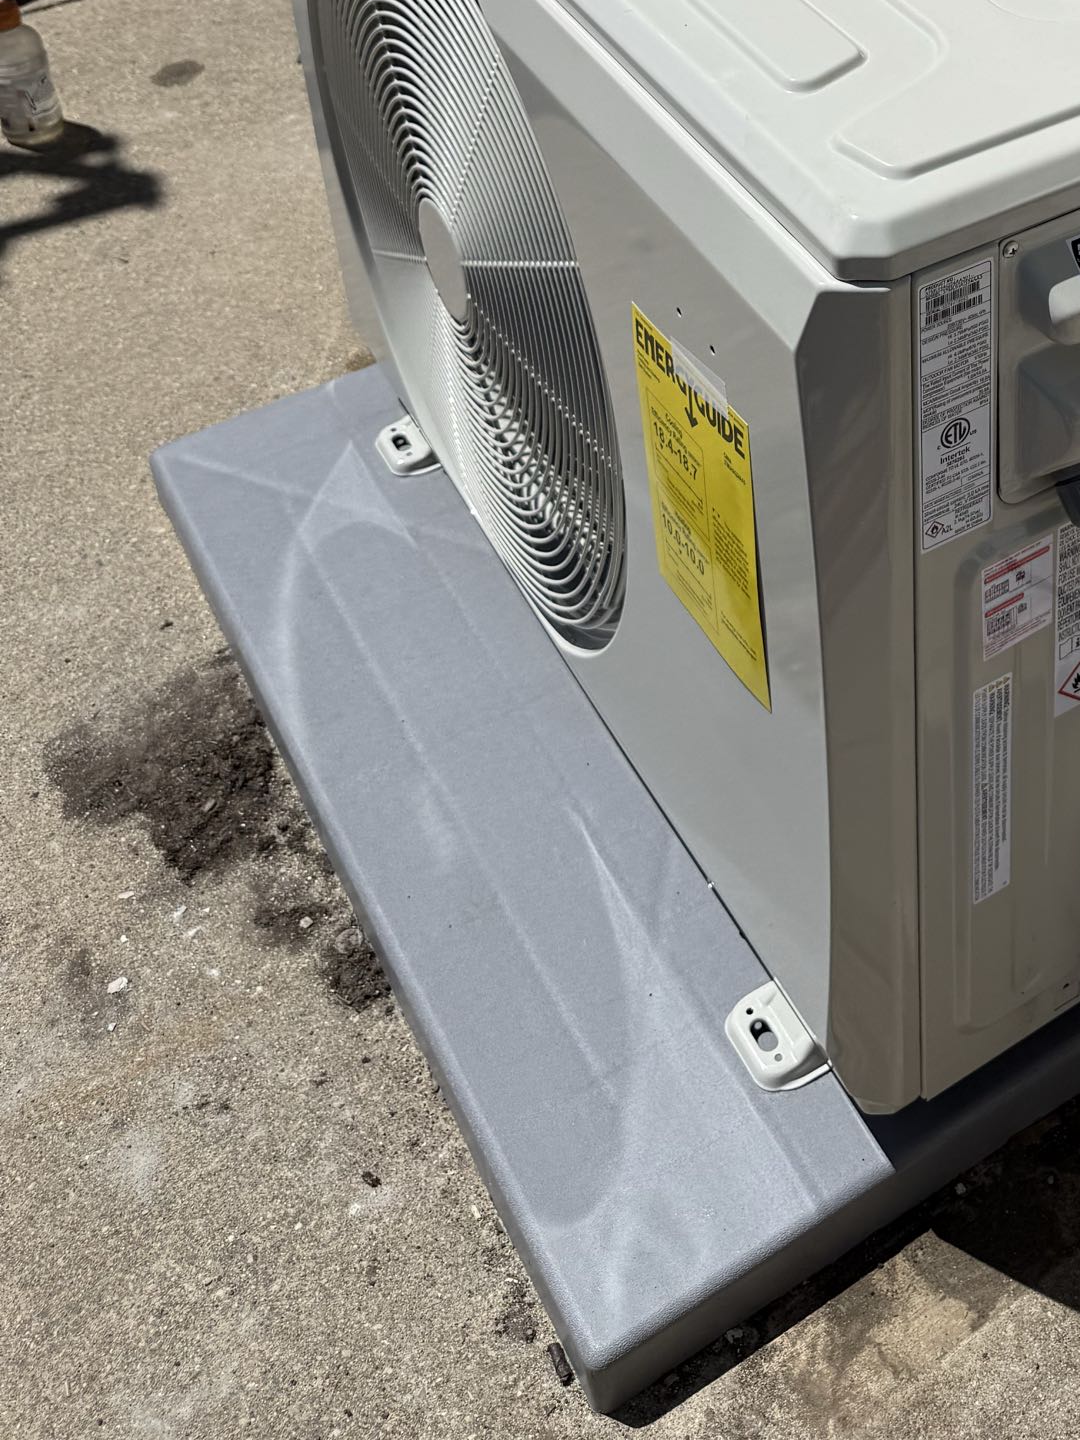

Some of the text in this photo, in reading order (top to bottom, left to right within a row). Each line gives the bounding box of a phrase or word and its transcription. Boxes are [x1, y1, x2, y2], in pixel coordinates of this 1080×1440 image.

[654, 423, 697, 479] 18.4-18.7
[940, 447, 969, 464] Intertek
[663, 514, 704, 574] 10.0-10.0
